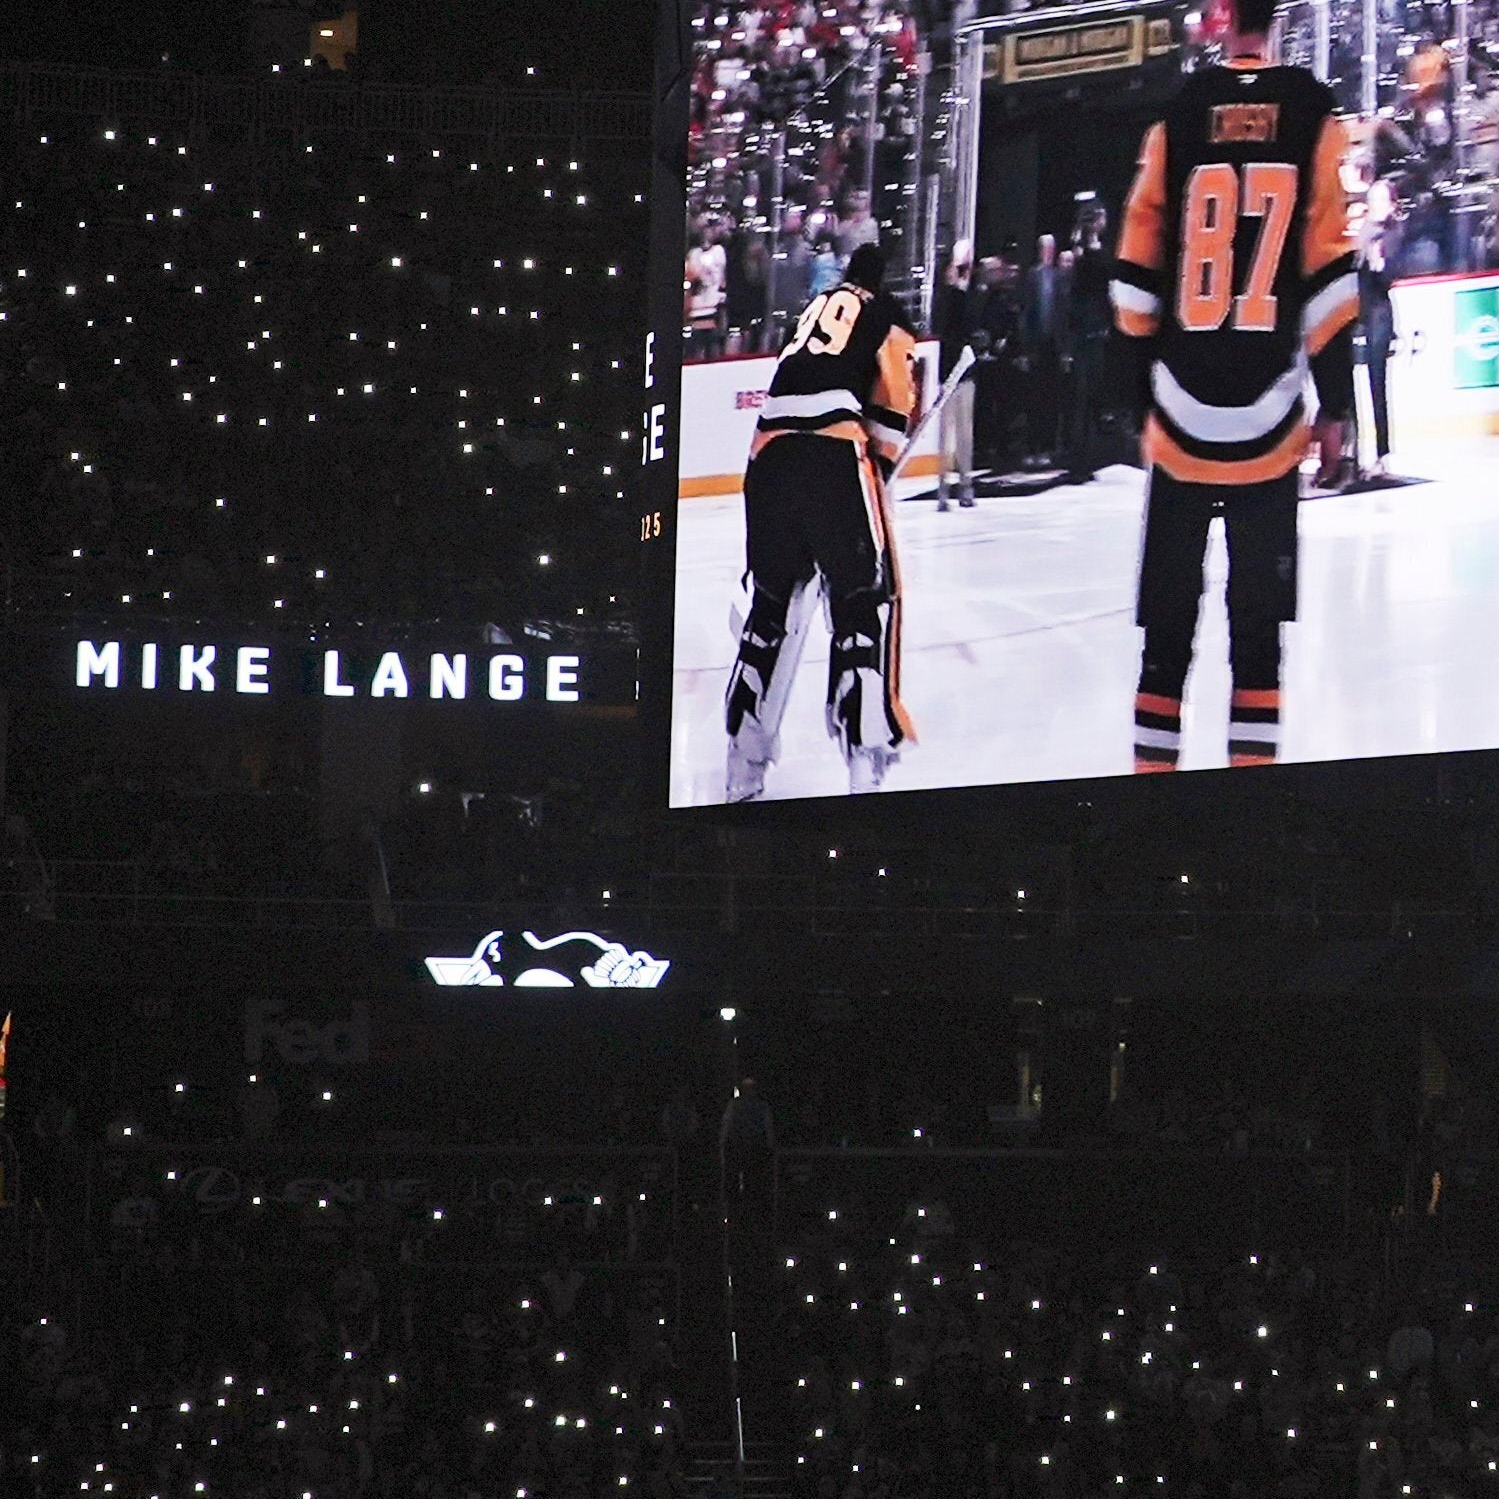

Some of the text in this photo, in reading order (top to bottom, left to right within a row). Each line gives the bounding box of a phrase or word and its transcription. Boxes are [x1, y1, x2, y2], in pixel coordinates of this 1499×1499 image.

[1177, 161, 1298, 332] 87
[75, 639, 581, 703] MIKE LANGE
